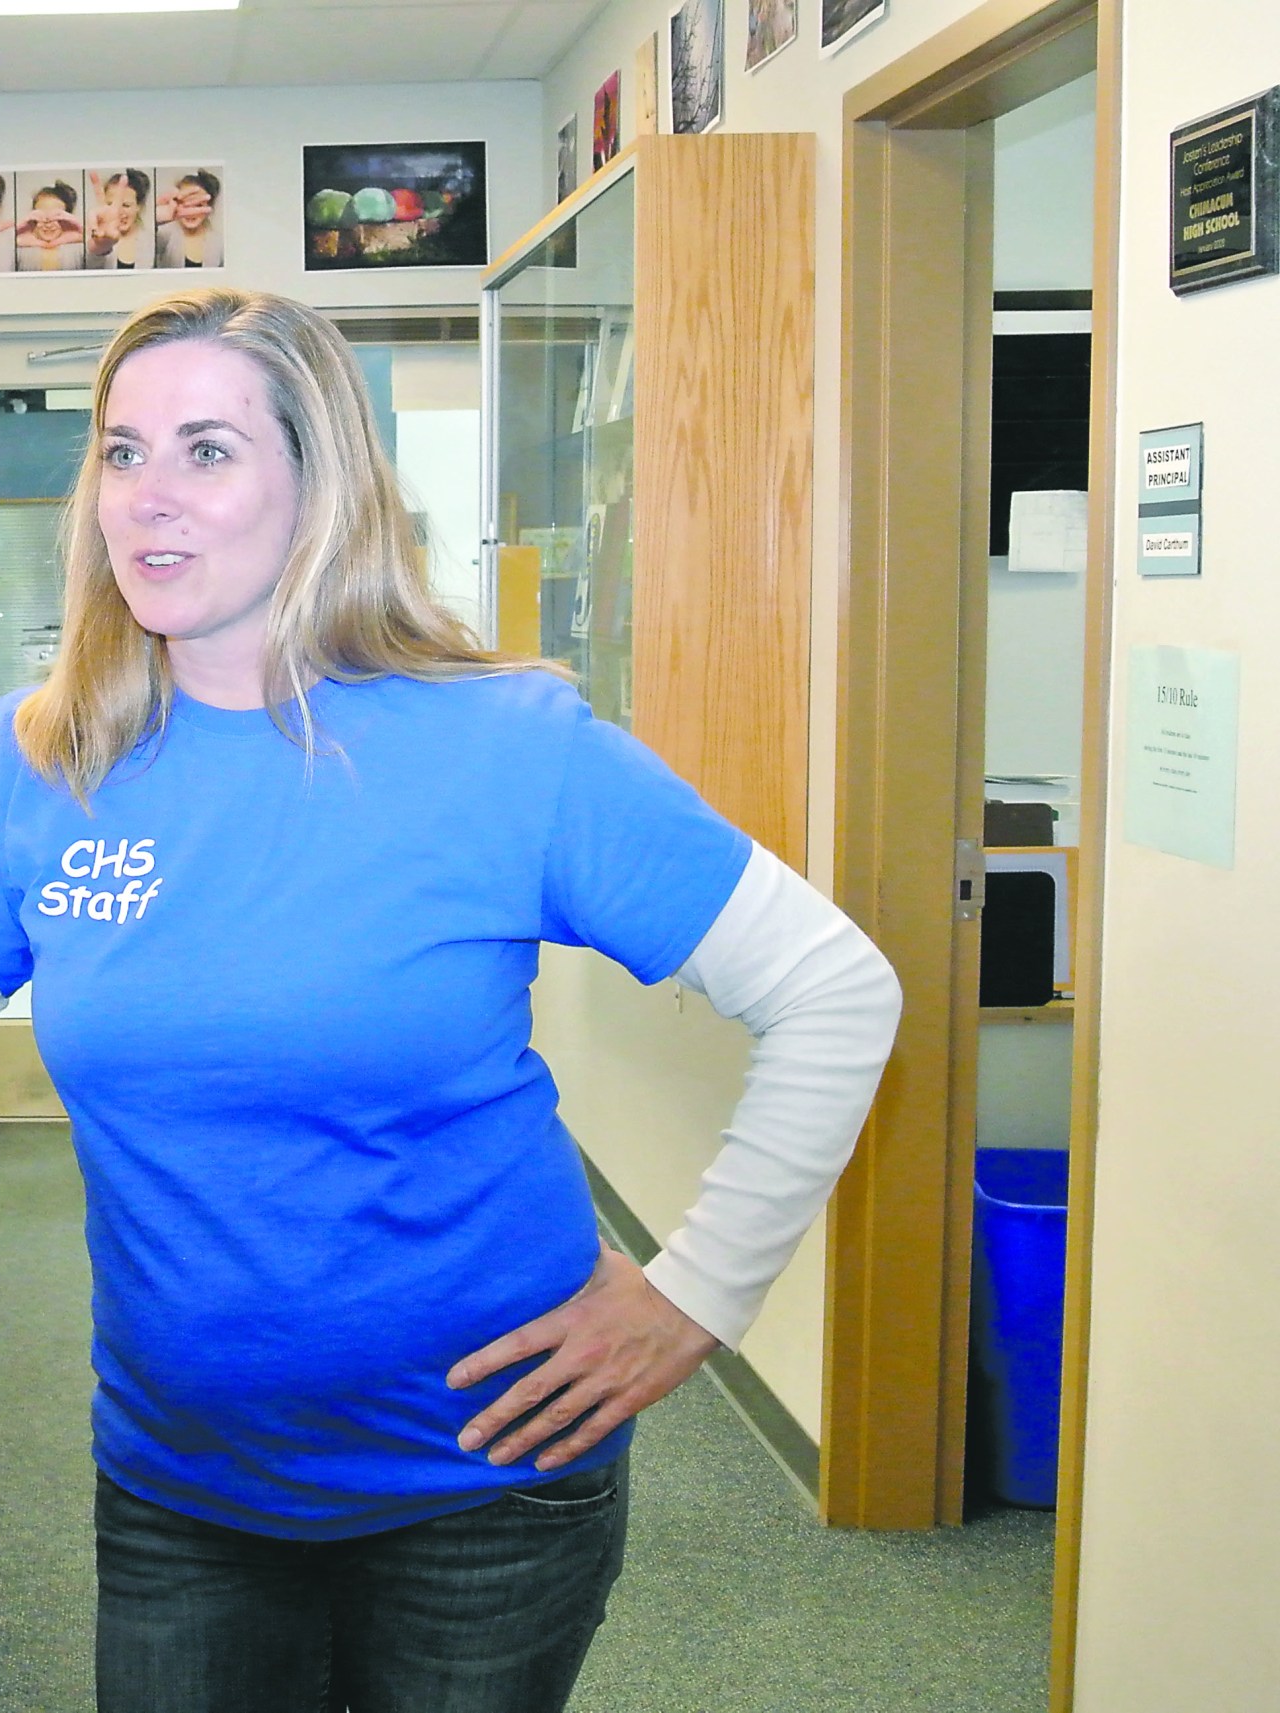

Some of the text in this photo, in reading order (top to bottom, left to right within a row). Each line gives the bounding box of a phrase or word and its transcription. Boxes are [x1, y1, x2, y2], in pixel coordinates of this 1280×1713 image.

[1207, 132, 1244, 156] Leadership
[1193, 154, 1230, 176] Conference
[1189, 192, 1234, 219] CHIMACUM
[1183, 211, 1240, 241] HIGH SCHOOL
[1147, 447, 1190, 464] ASSISTANT
[1148, 471, 1187, 486] PRINCIPAL
[1146, 539, 1162, 551] David
[1157, 686, 1198, 708] 15/10 Rule
[61, 838, 155, 879] CHS
[37, 877, 163, 925] Staff
